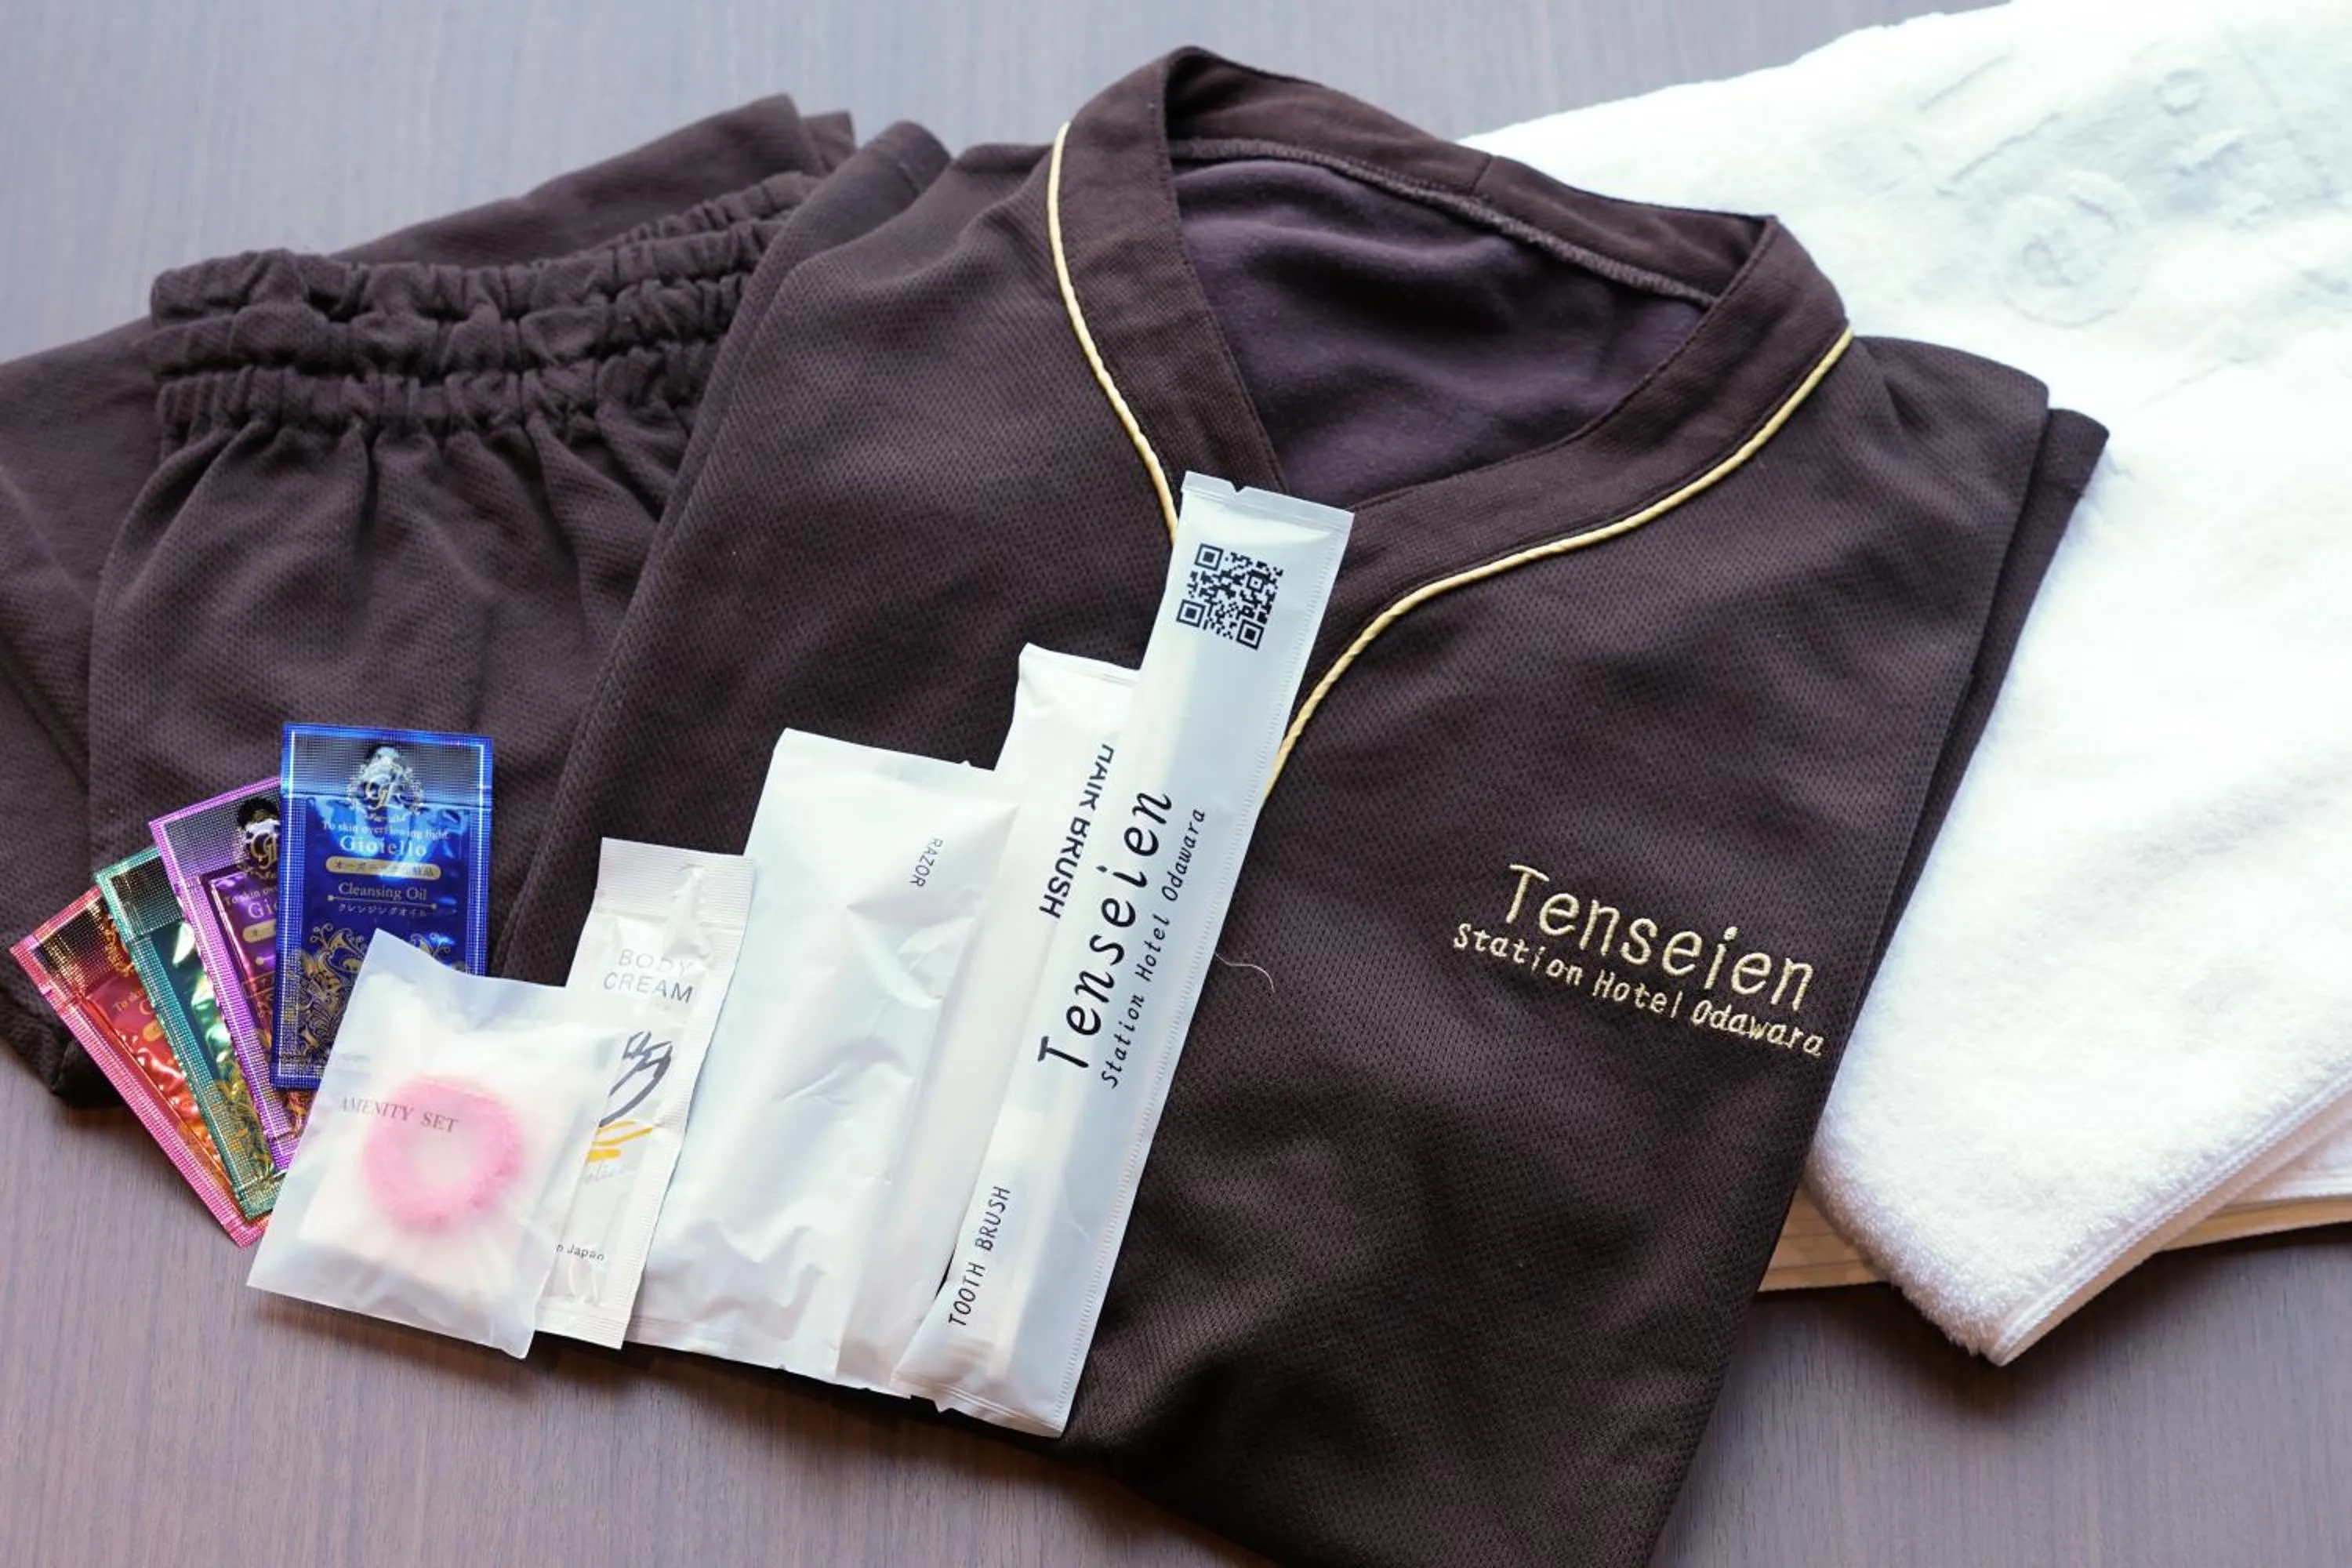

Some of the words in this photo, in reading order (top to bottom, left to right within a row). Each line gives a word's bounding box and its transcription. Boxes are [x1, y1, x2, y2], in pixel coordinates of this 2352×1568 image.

[339, 834, 426, 857] Gioiello
[909, 837, 943, 889] RAZOR
[1038, 816, 1091, 920] BRUSH
[338, 881, 402, 902] Cleansing
[406, 886, 427, 902] Oil
[1037, 789, 1172, 1069] Tenseien
[1101, 993, 1145, 1089] Station
[1134, 913, 1171, 982] Hotel
[1161, 808, 1206, 902] Odawara
[1504, 863, 1814, 1011] Tenseien
[603, 971, 693, 1004] CREAM
[619, 948, 693, 977] BODY
[1452, 922, 1584, 987] Station
[1592, 968, 1683, 1019] Hotel
[1691, 999, 1827, 1058] Odawara
[339, 1095, 415, 1121] AMENITY
[420, 1110, 459, 1134] SET
[567, 1243, 605, 1262] Japan
[949, 1262, 986, 1326] TOOTH
[975, 1185, 1011, 1251] BRUSH
